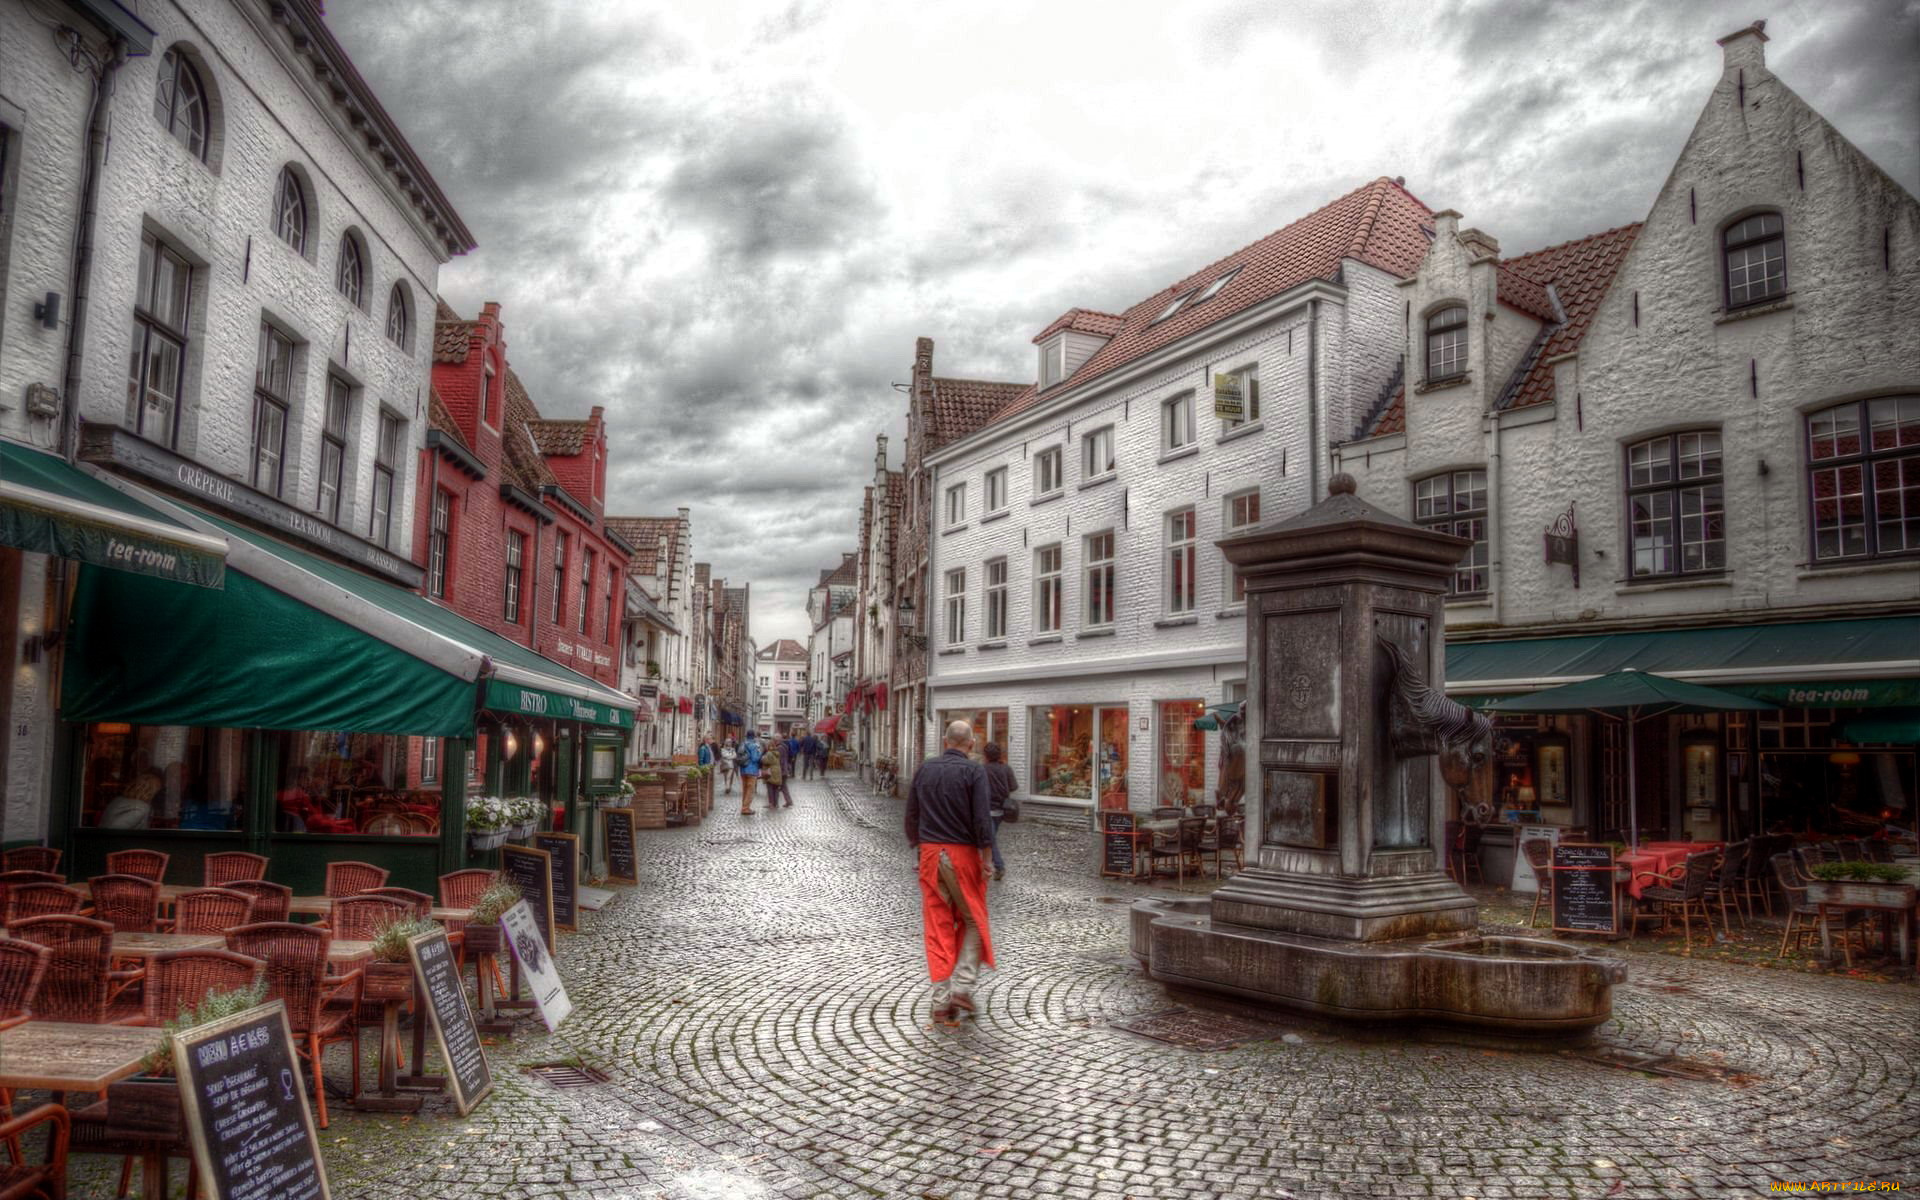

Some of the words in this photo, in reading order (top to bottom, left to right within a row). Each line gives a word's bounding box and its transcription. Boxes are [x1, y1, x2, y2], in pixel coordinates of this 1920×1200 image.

[177, 463, 235, 503] CRÊPERIE
[106, 537, 177, 571] tea-room
[366, 550, 399, 576] BRASSERIE
[520, 690, 548, 714] BISTRO
[1788, 688, 1869, 703] tea-room
